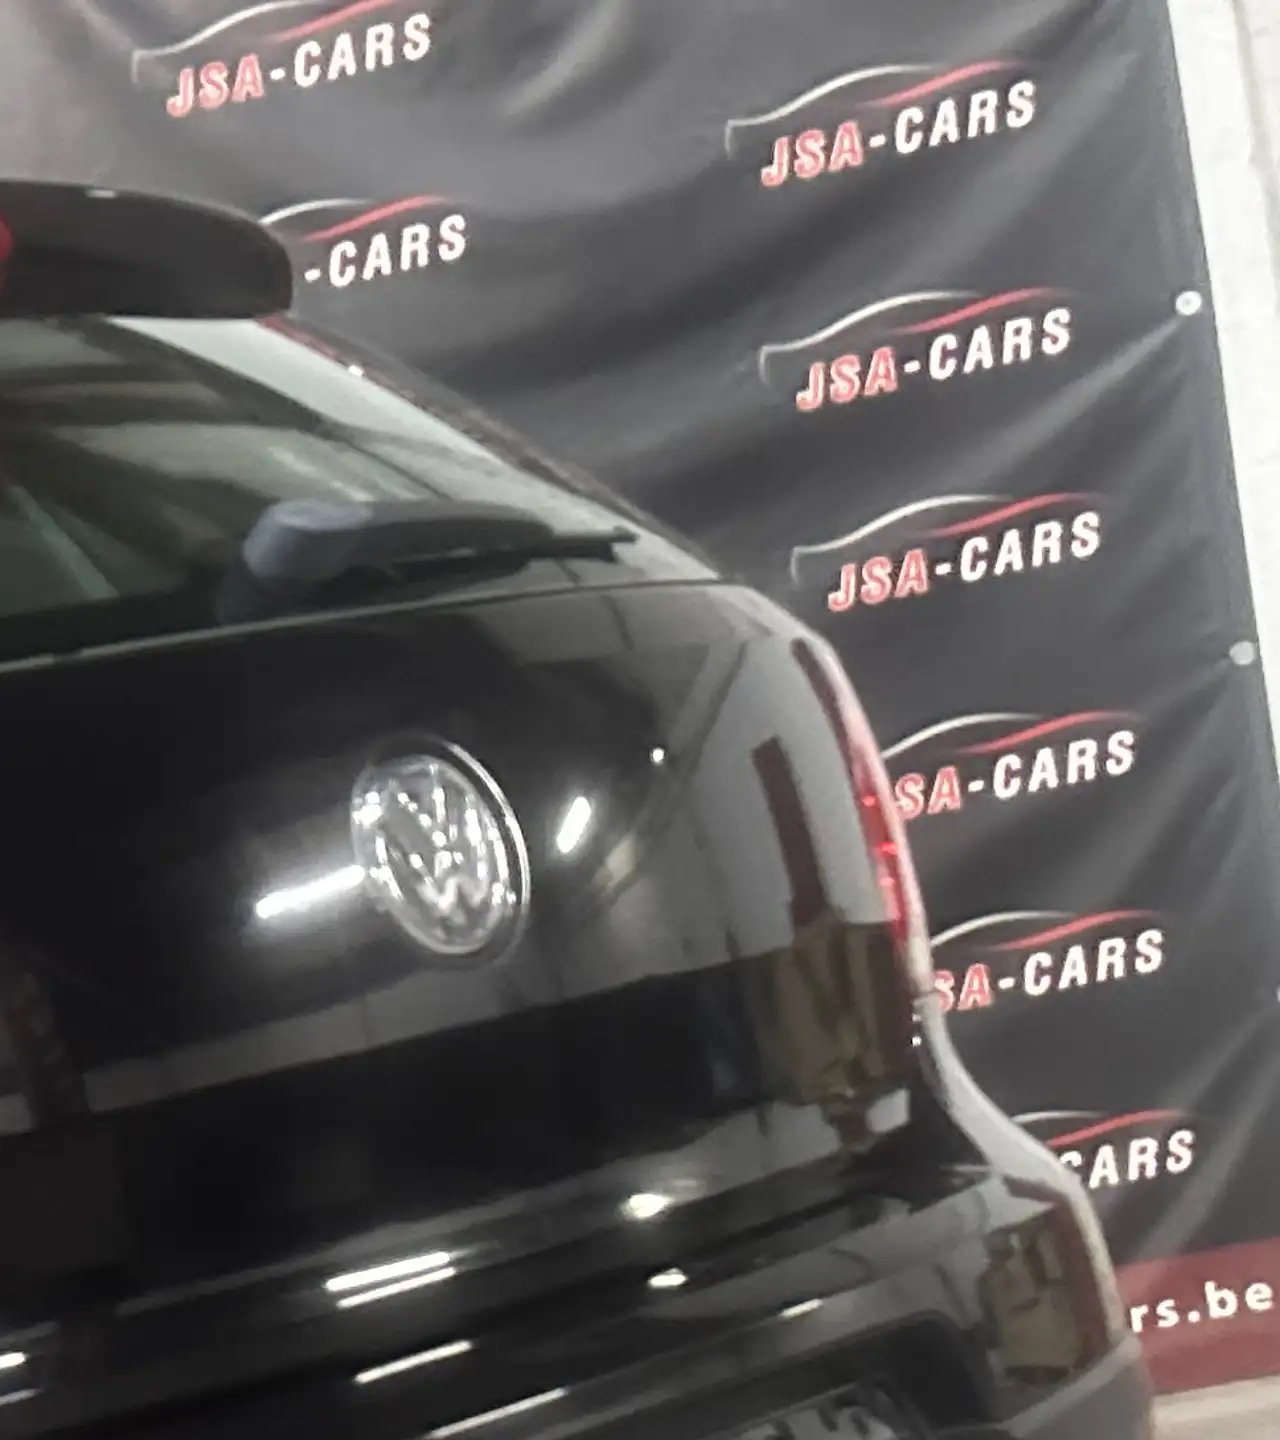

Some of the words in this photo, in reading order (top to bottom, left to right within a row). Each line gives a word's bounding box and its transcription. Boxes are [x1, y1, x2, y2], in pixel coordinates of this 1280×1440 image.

[166, 13, 432, 118] JSA-CARS
[760, 80, 1036, 187] JSA-CARS
[304, 213, 468, 288] -CARS
[795, 307, 1072, 412] JSA-CARS
[828, 511, 1101, 612] JSA-CARS
[894, 730, 1137, 820] SA-CARS
